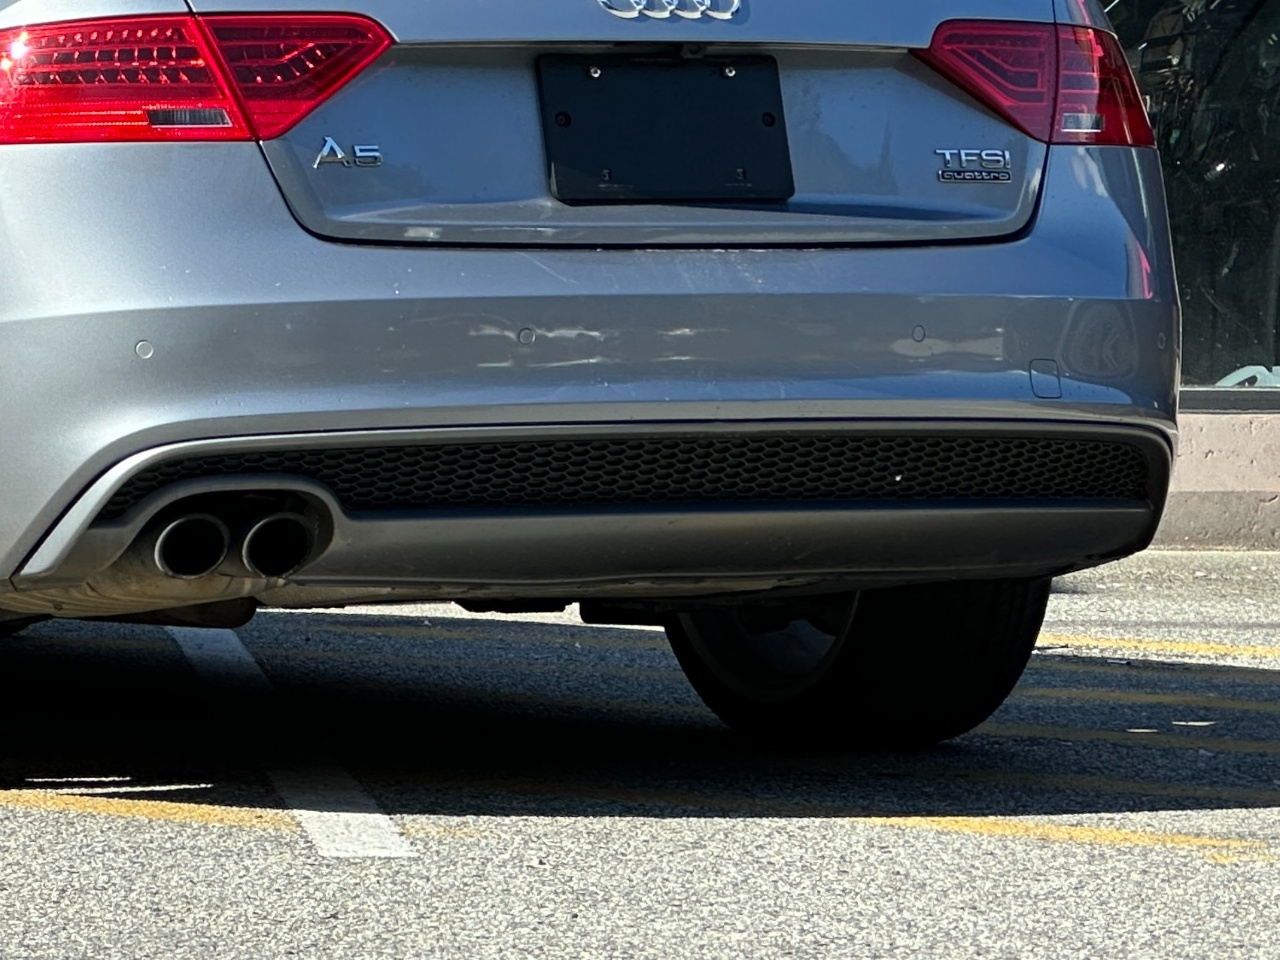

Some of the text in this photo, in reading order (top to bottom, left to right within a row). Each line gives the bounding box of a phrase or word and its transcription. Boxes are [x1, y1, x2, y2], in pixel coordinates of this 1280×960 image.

[312, 136, 383, 168] A5
[935, 149, 1011, 169] TFSI
[941, 171, 1011, 182] quattro
